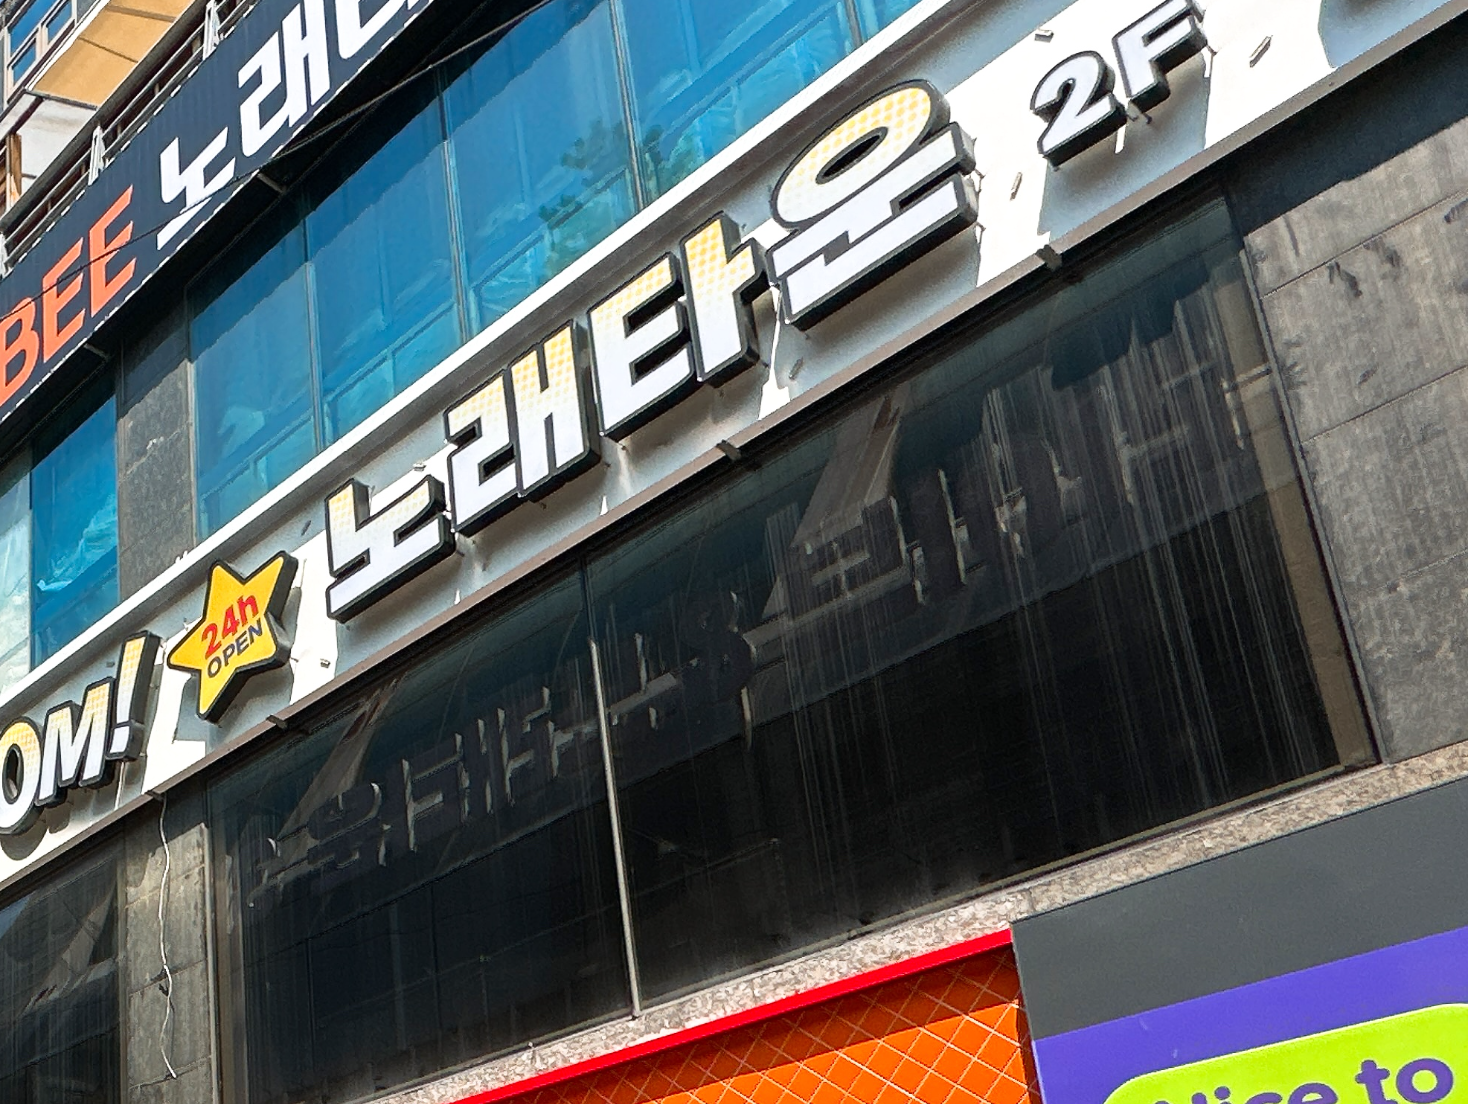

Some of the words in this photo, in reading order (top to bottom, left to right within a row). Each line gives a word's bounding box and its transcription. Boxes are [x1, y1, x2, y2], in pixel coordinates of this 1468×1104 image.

[1030, 0, 1206, 160] 2F
[326, 78, 978, 623] 노래타운
[200, 592, 259, 658] 24h
[206, 616, 264, 679] OPEN
